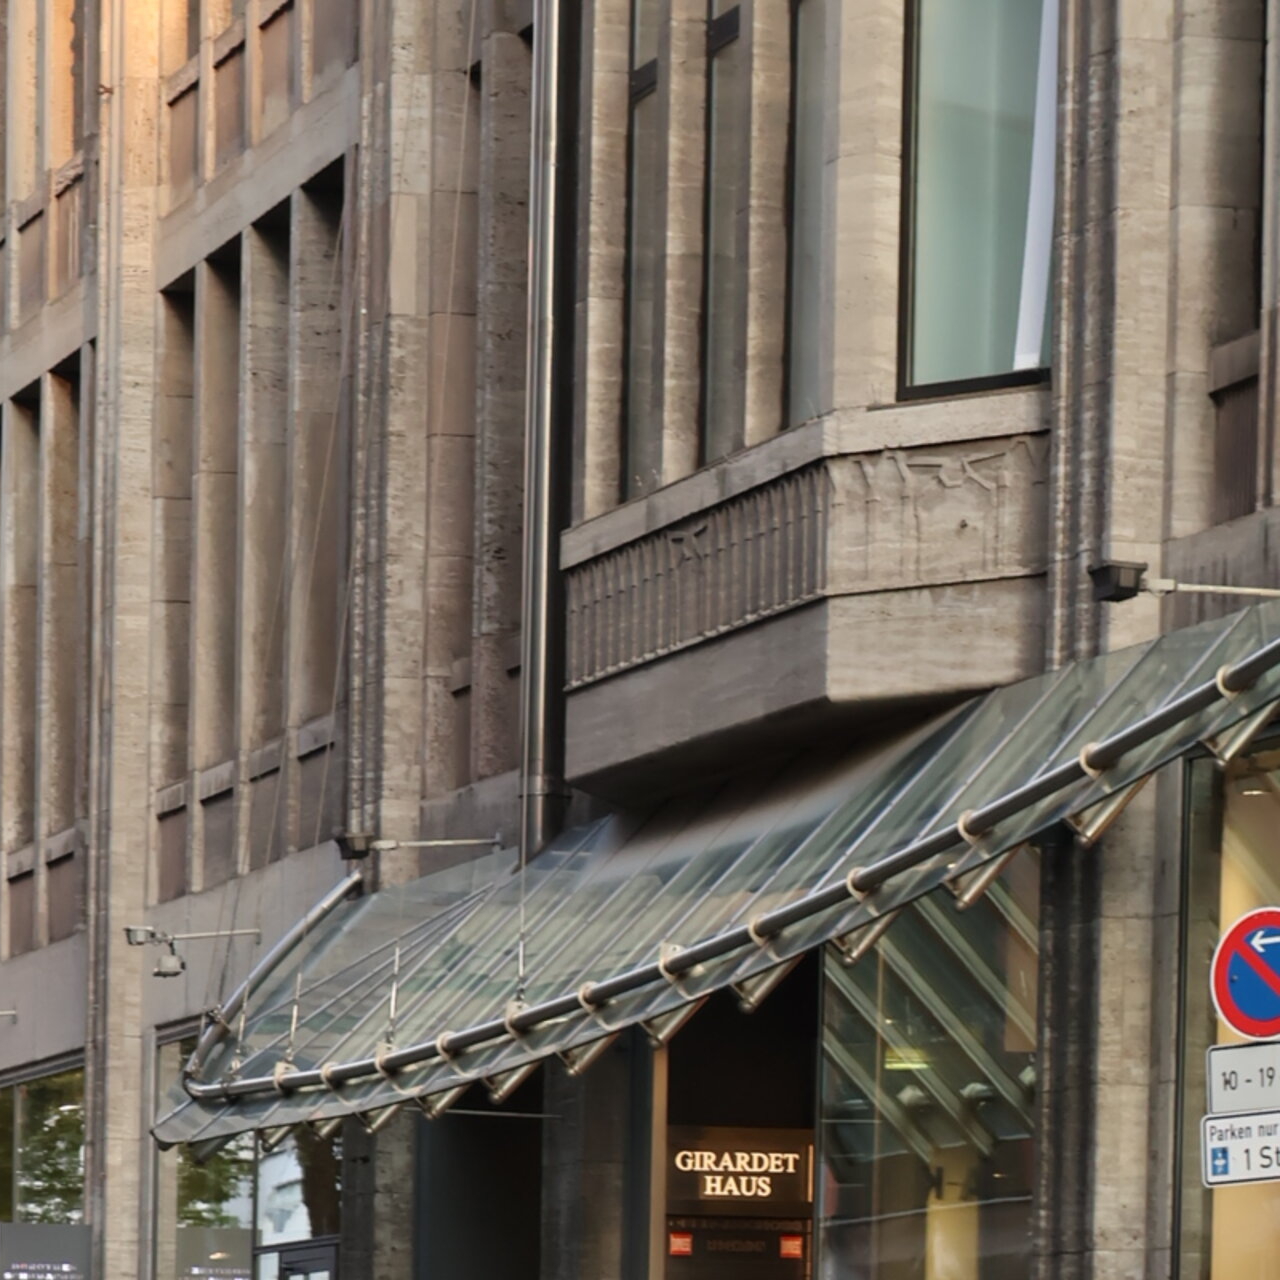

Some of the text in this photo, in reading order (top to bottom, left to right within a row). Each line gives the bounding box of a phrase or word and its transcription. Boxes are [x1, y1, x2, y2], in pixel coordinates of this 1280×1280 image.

[1259, 1067, 1276, 1088] 19
[1209, 1123, 1279, 1142] Parken nur
[674, 1150, 800, 1173] GIRARDET
[1244, 1148, 1251, 1171] 1
[703, 1175, 772, 1197] HAUS
